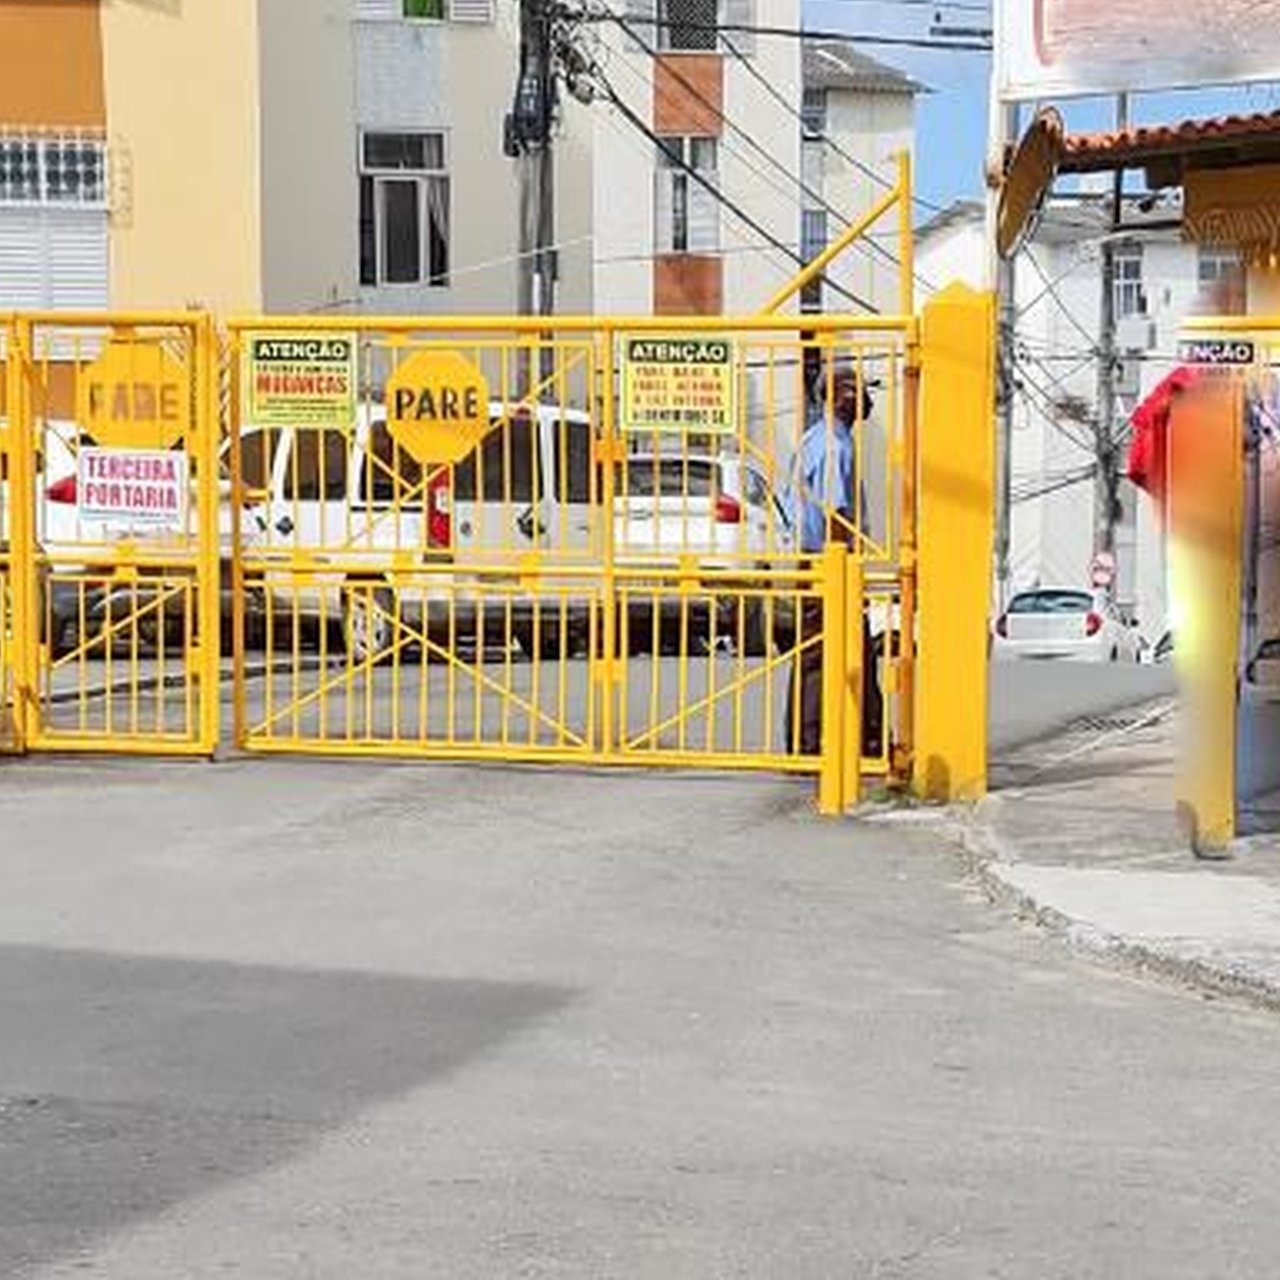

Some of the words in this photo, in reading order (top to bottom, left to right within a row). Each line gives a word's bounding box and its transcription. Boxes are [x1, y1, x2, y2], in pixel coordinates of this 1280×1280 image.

[259, 340, 346, 359] ATENÇÃO
[632, 342, 725, 363] ATENÇÃO
[395, 386, 478, 420] PARE
[87, 456, 175, 481] TERCEIRA
[86, 483, 177, 509] PORTARIA
